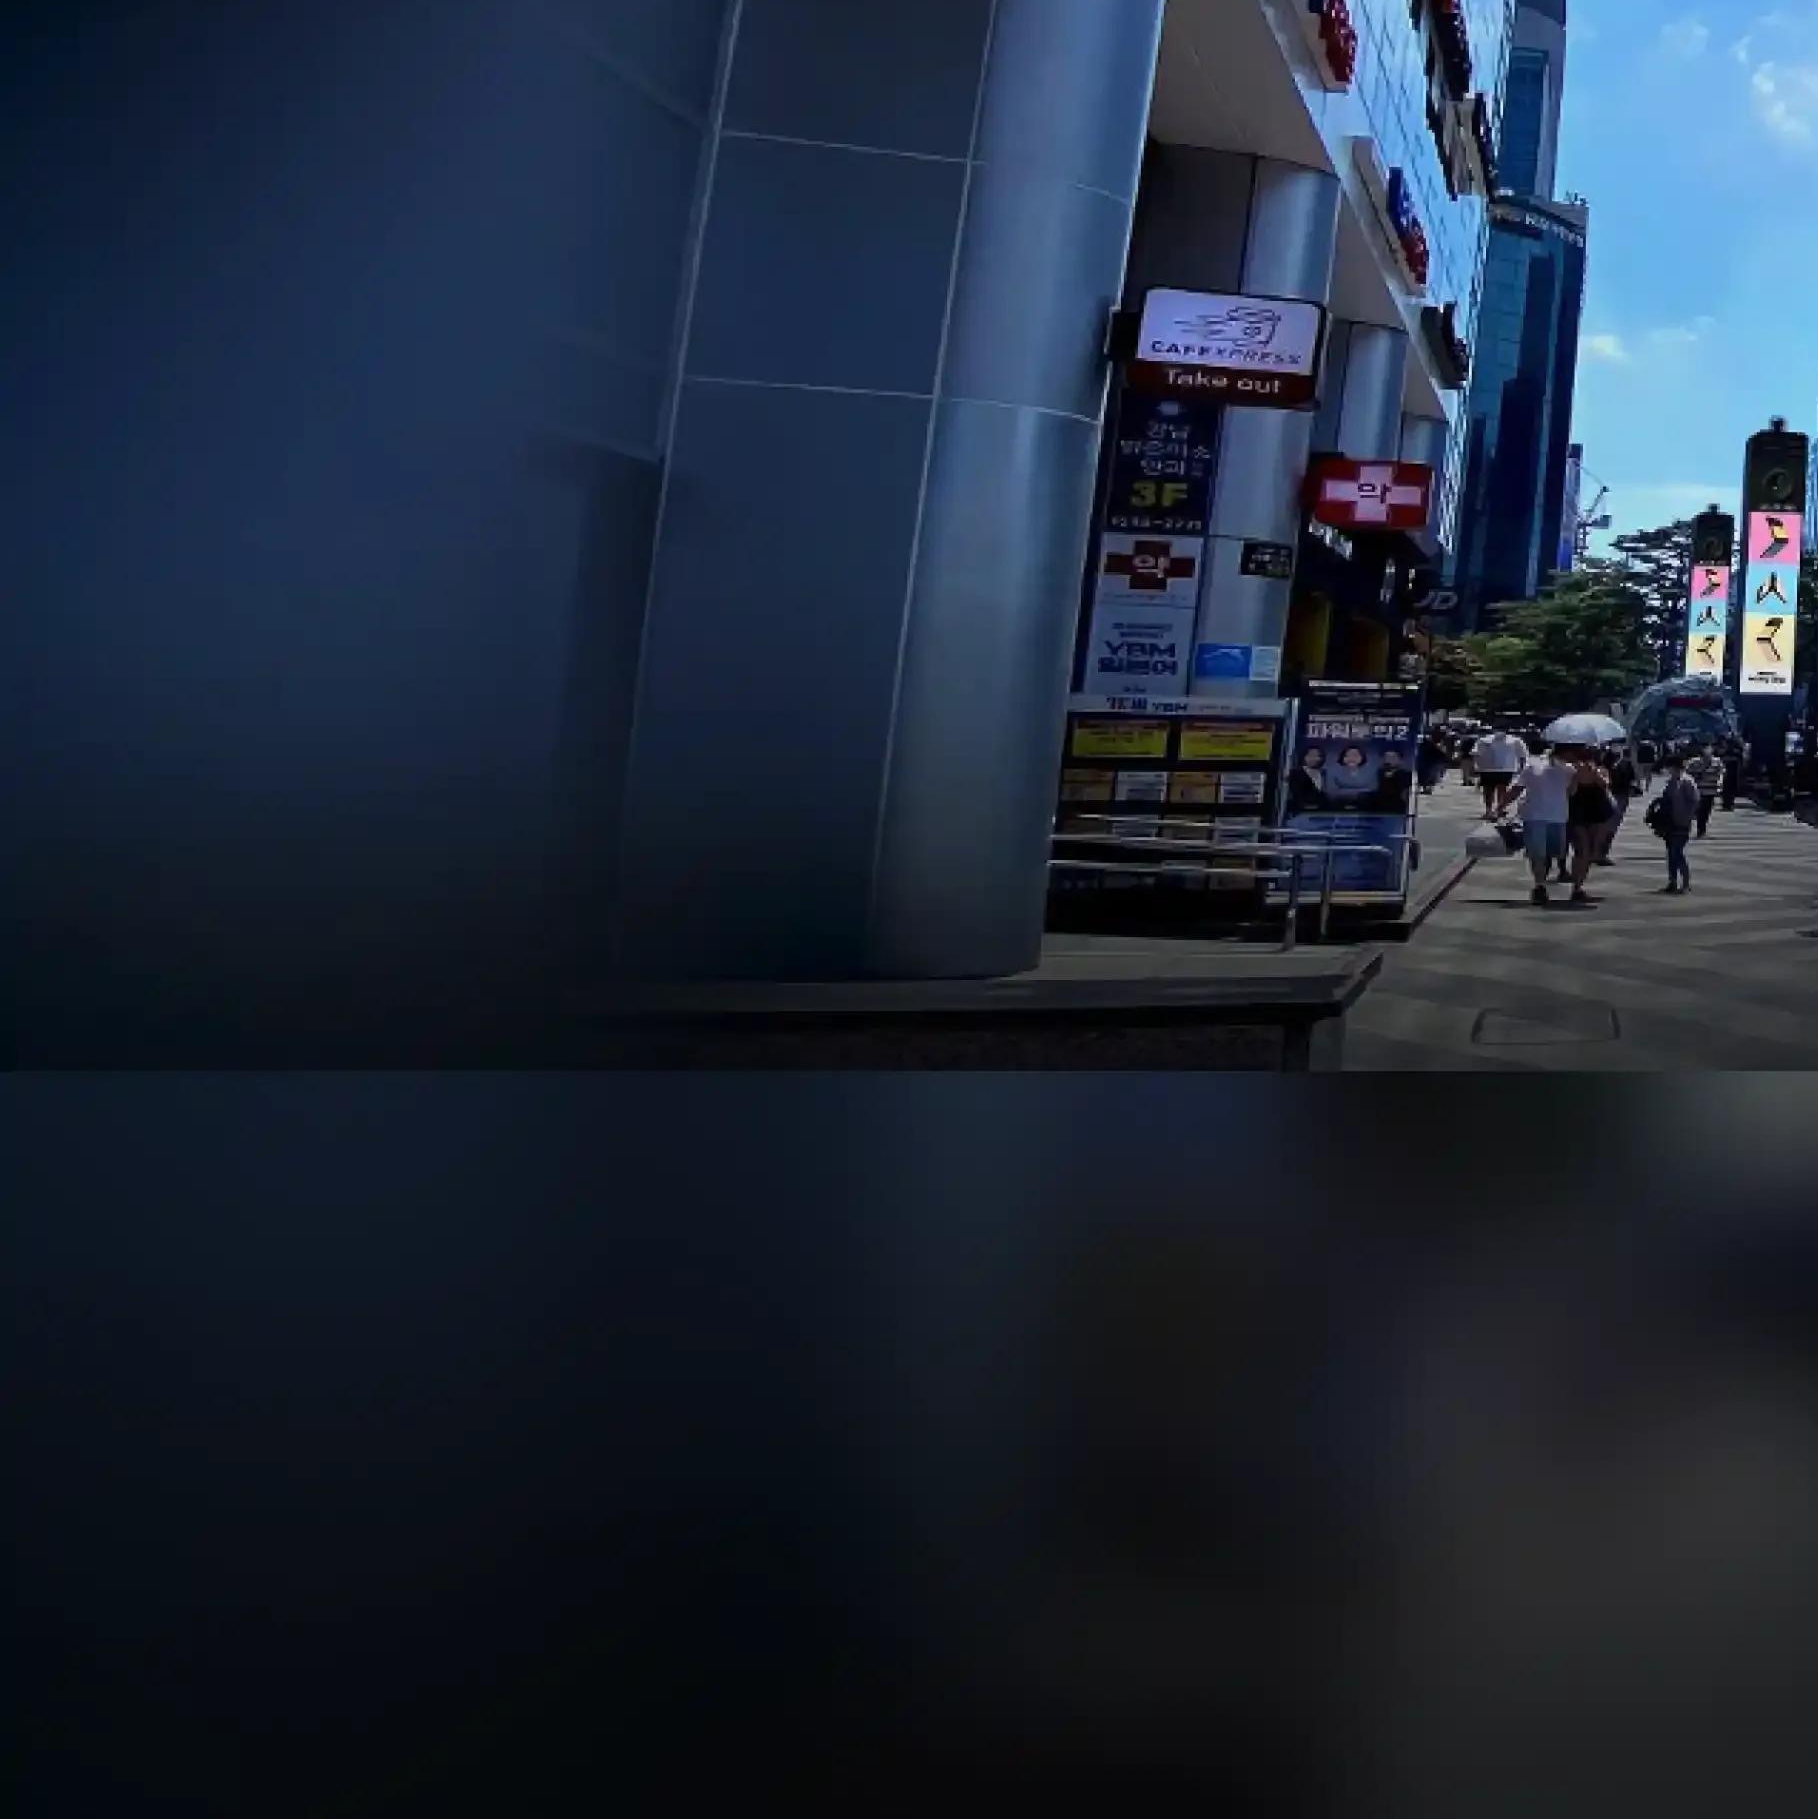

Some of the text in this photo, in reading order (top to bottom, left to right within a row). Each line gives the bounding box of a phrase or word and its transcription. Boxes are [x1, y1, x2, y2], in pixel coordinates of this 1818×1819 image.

[1167, 369, 1281, 394] Take out
[1130, 481, 1189, 508] 3F
[1357, 482, 1392, 504] 약
[1132, 554, 1171, 579] 약
[1103, 640, 1176, 658] YBM
